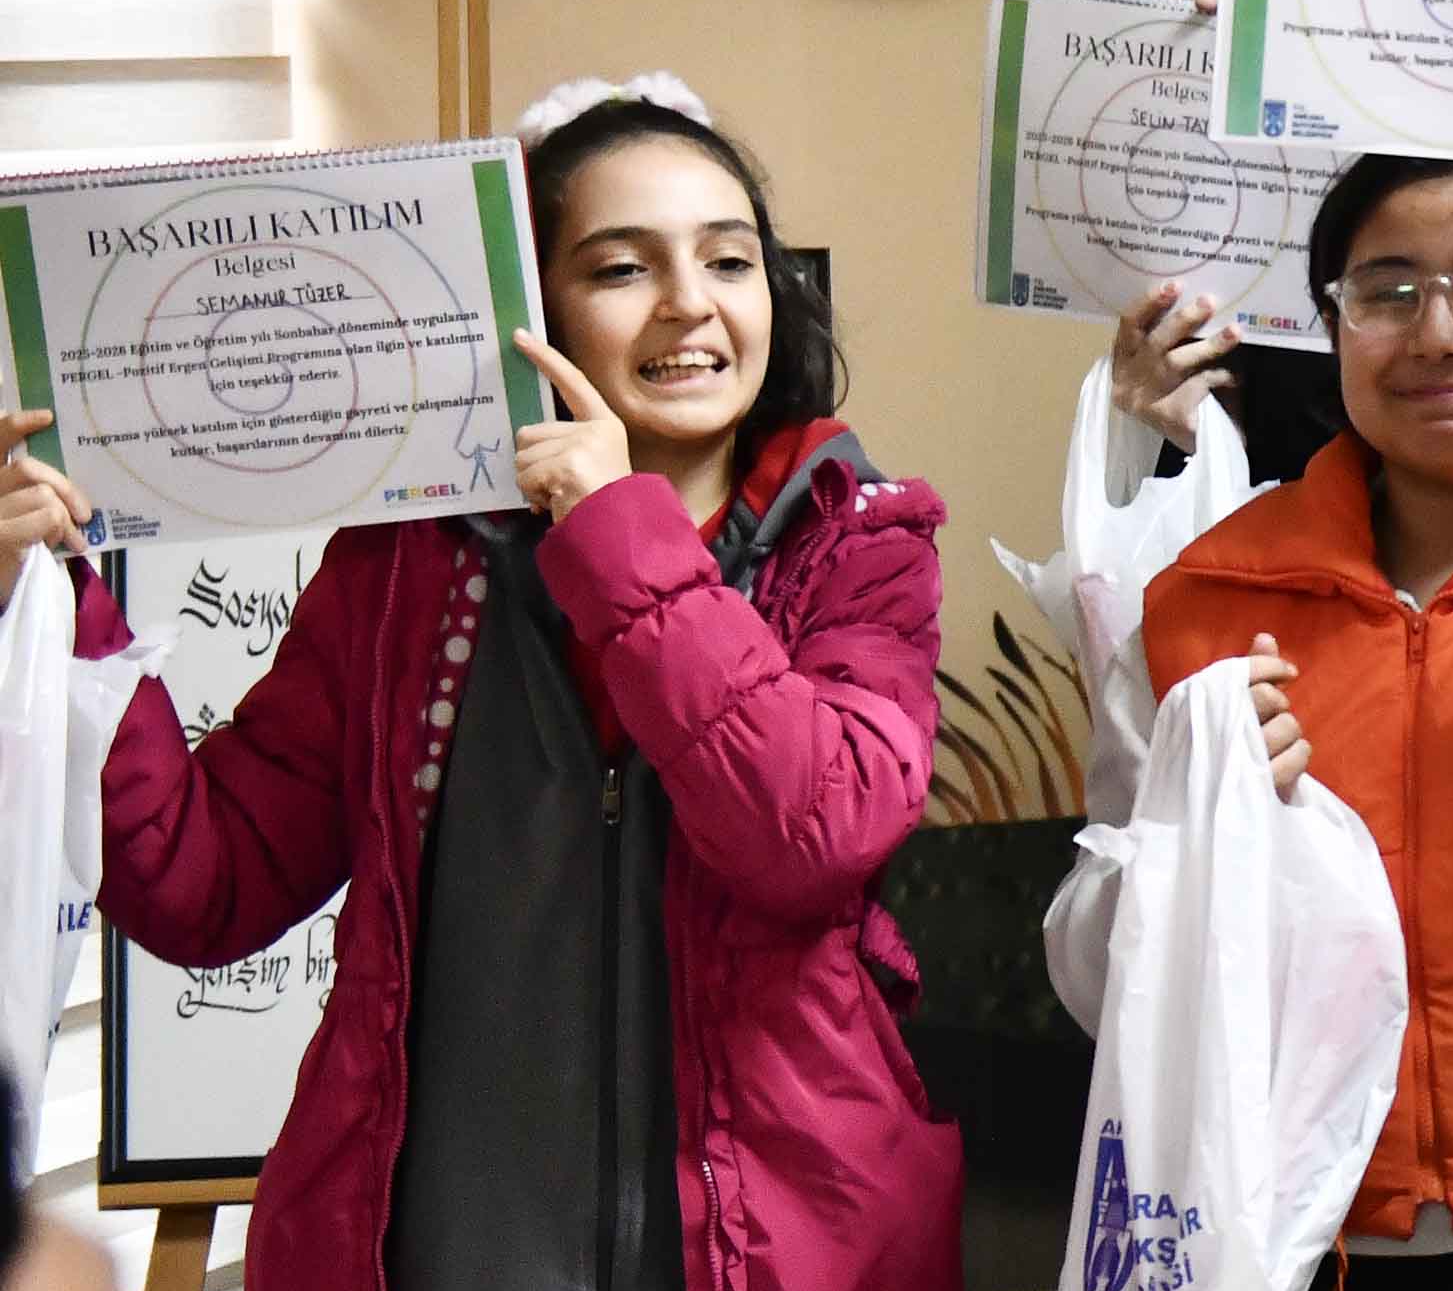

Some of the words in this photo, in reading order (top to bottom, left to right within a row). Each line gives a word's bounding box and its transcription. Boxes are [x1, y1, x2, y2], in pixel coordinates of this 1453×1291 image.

[1064, 34, 1194, 72] BAŞARILI
[1151, 78, 1210, 104] Belges
[87, 214, 259, 259] BAŞARILI
[268, 198, 424, 241] KATILIM
[213, 251, 297, 279] Belgesi
[195, 287, 288, 317] SEMANUR
